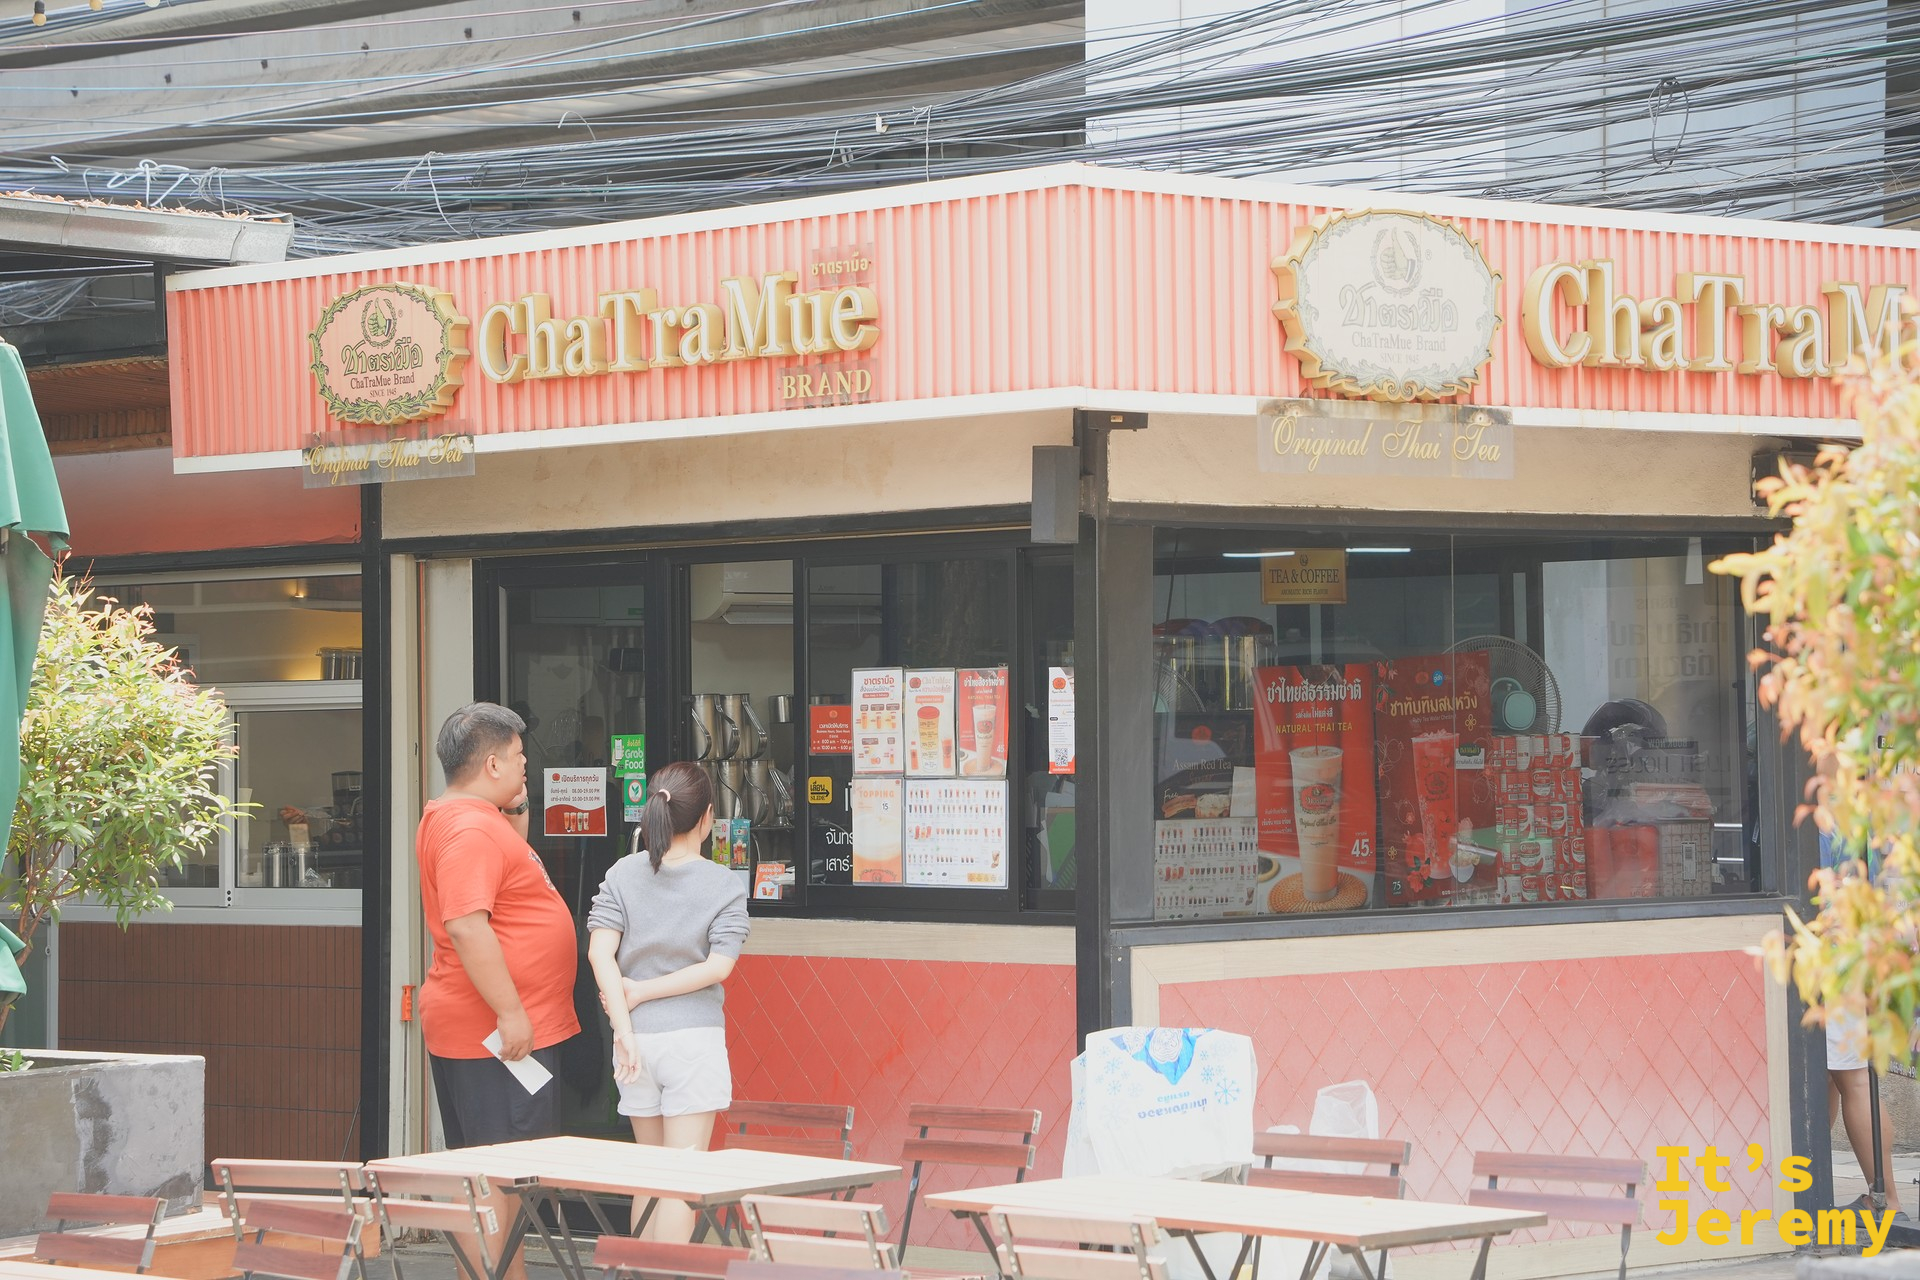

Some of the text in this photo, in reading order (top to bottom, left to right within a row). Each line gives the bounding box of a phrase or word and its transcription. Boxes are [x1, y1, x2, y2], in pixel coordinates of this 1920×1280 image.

[811, 252, 871, 277] ชาตรามือ
[1338, 281, 1458, 332] ชาตรามือ
[476, 270, 880, 384] ChaTraMue
[1522, 257, 1920, 380] ChaTraM
[1352, 331, 1446, 352] ChaTraMue Brand
[341, 337, 423, 376] ชาตรามือ
[350, 372, 415, 390] ChaTraMue Brand
[781, 368, 873, 400] BRAND
[1271, 414, 1501, 473] Original Thai Tea
[309, 433, 464, 485] Original Thai Tea
[1269, 568, 1340, 584] TEA & COFFEE
[1275, 721, 1353, 734] NATURAL THAI TEA
[625, 748, 643, 759] Grab
[625, 759, 644, 769] Food
[1173, 758, 1232, 770] Assam Red Tea
[810, 781, 826, 792] เลื่อน
[860, 789, 895, 798] TOPPING
[1163, 788, 1178, 804] Free
[825, 828, 853, 845] จันทร
[826, 855, 853, 872] เสาร์-
[1392, 881, 1401, 890] 75
